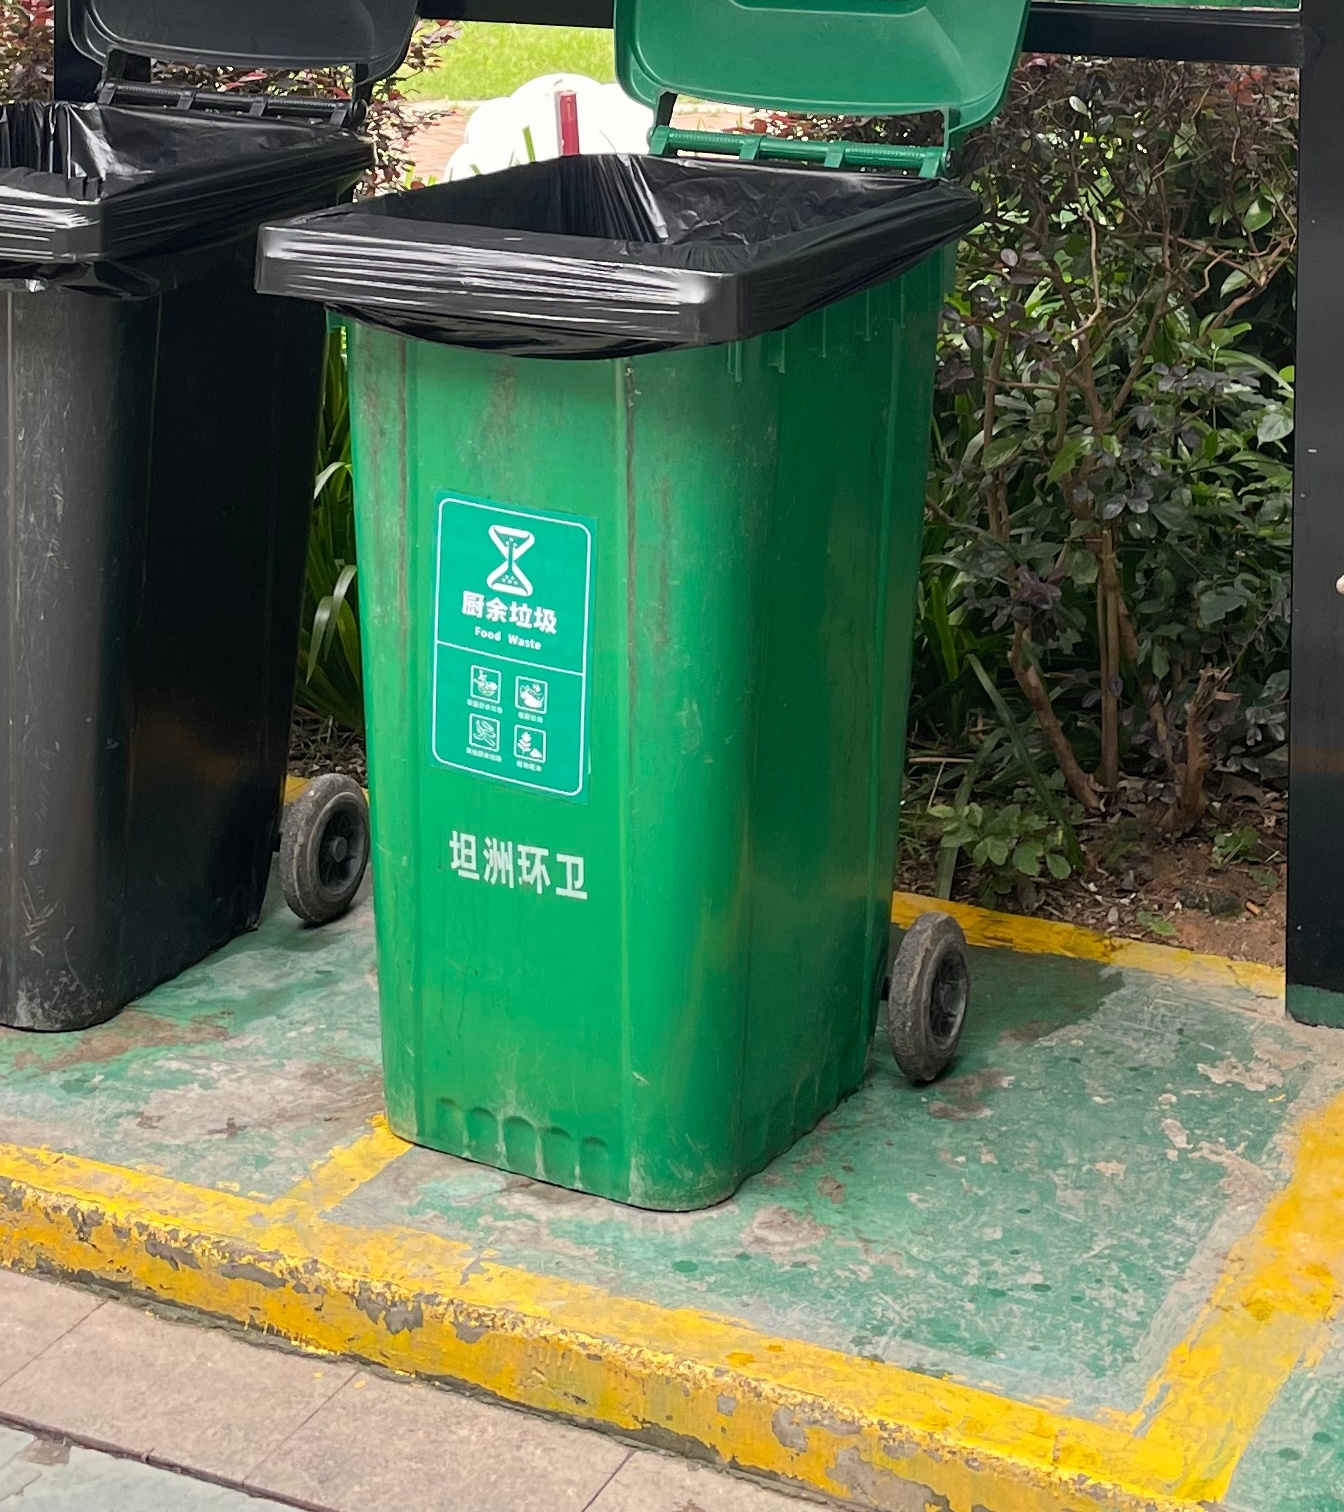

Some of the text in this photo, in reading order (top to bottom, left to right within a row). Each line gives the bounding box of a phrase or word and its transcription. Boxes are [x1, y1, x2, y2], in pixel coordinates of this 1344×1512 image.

[461, 590, 557, 635] 厨余垃圾
[474, 626, 542, 651] Food Waste
[448, 830, 589, 901] 坦洲环卫
